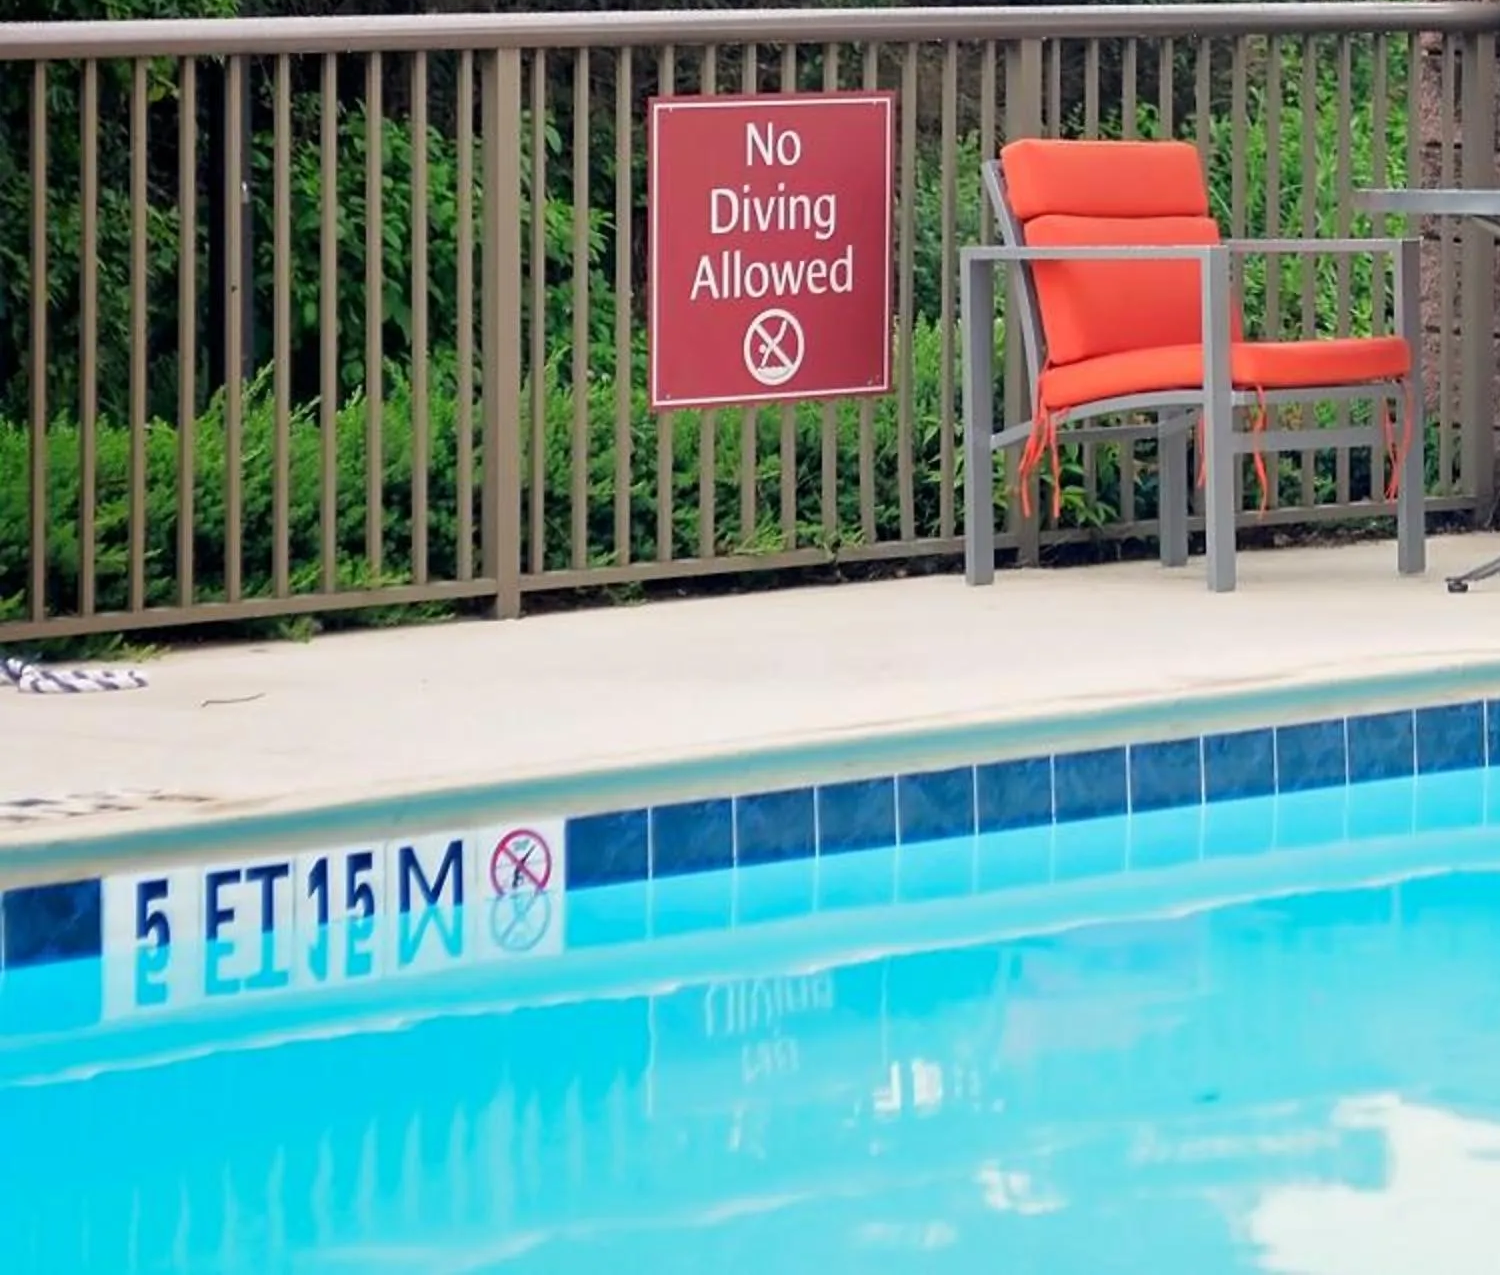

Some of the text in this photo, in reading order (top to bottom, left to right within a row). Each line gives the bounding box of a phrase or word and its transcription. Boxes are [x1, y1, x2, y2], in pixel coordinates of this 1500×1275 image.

[746, 122, 801, 166] No
[710, 182, 836, 240] Diving
[690, 244, 854, 301] Allowed
[136, 878, 171, 948] 5
[205, 863, 290, 942] FT
[399, 839, 464, 914] M
